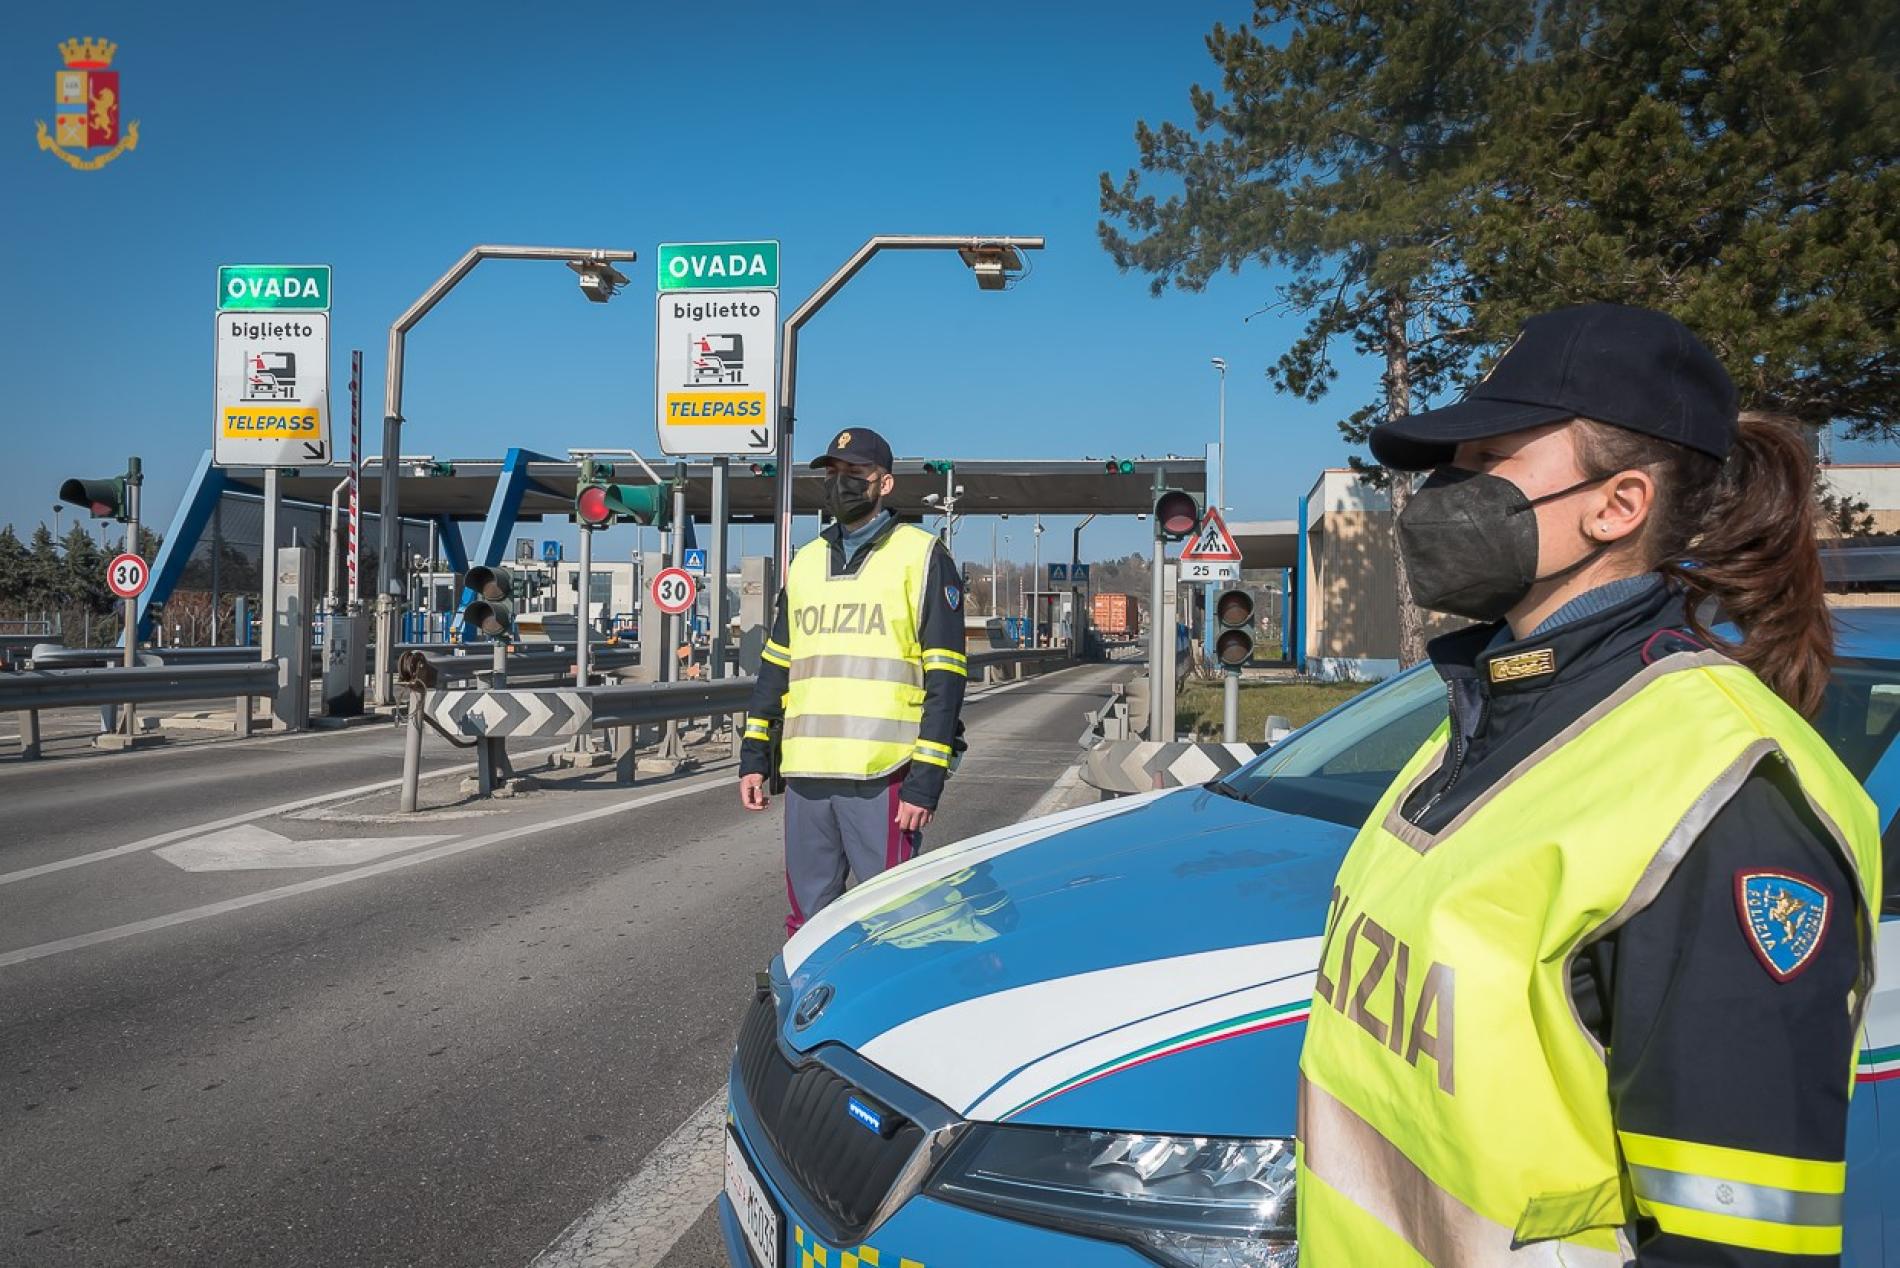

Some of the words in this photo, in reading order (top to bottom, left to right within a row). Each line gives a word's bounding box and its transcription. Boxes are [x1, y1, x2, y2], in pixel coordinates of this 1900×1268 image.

[668, 253, 768, 278] OVADA
[227, 277, 320, 298] OVADA
[674, 302, 760, 321] biglietto
[232, 321, 313, 339] biglietto
[669, 400, 761, 417] TELEPASS
[227, 415, 315, 431] TELEPASS
[117, 566, 140, 585] 30
[1192, 565, 1210, 576] 25
[1218, 568, 1230, 576] m
[661, 580, 686, 601] 30
[1747, 888, 1777, 951] POLIZIA
